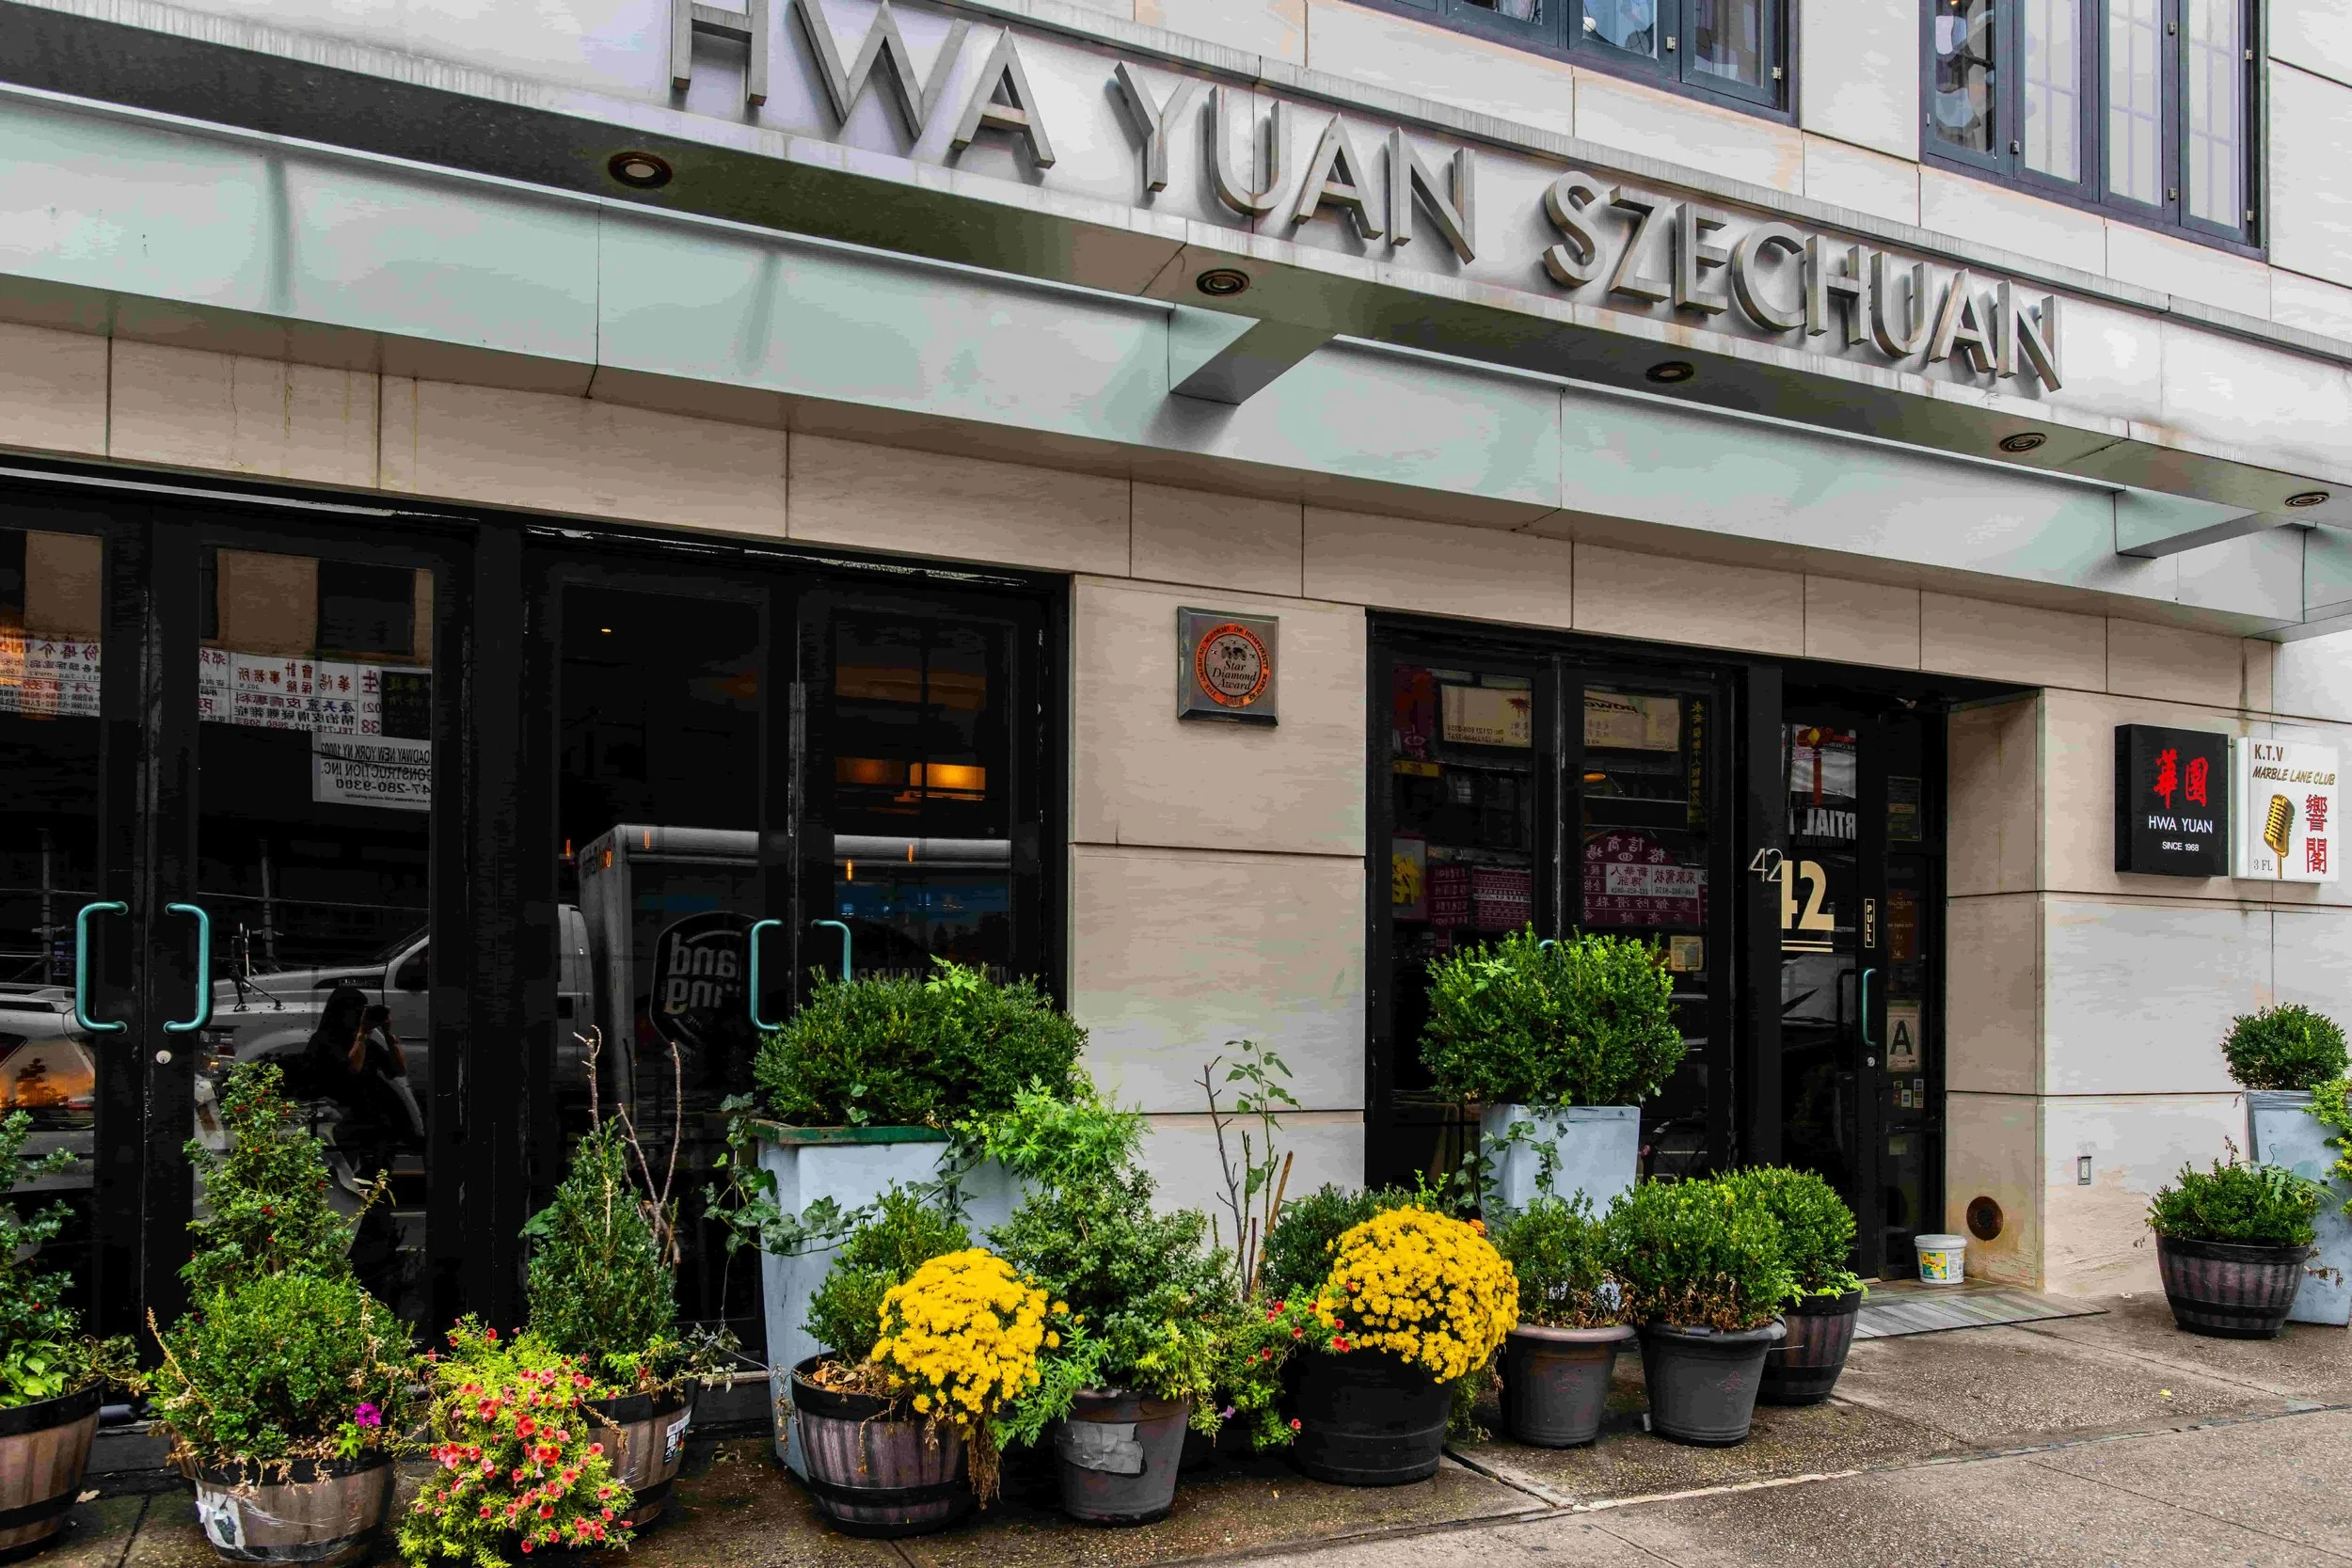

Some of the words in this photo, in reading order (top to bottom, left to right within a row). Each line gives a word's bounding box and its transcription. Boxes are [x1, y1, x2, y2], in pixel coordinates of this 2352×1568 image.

[671, 0, 1056, 169] HWA
[1112, 60, 1476, 265] YUAN
[1542, 170, 2062, 392] SZECHUAN
[1224, 660, 1246, 671] Star
[1212, 668, 1257, 681] Diamond
[1217, 679, 1251, 689] Award
[2254, 744, 2283, 762] K.T.V
[2252, 766, 2288, 782] MARBLE
[2290, 769, 2312, 784] LANE
[2313, 770, 2335, 785] CLUB
[2148, 816, 2176, 832] HWA
[2182, 817, 2213, 833] YUAN
[2162, 841, 2183, 851] SINCE
[2185, 843, 2200, 852] 1968
[1748, 848, 1783, 882] 42
[2253, 860, 2260, 871] 3
[2262, 860, 2273, 872] FL
[1889, 1020, 1913, 1054] A
